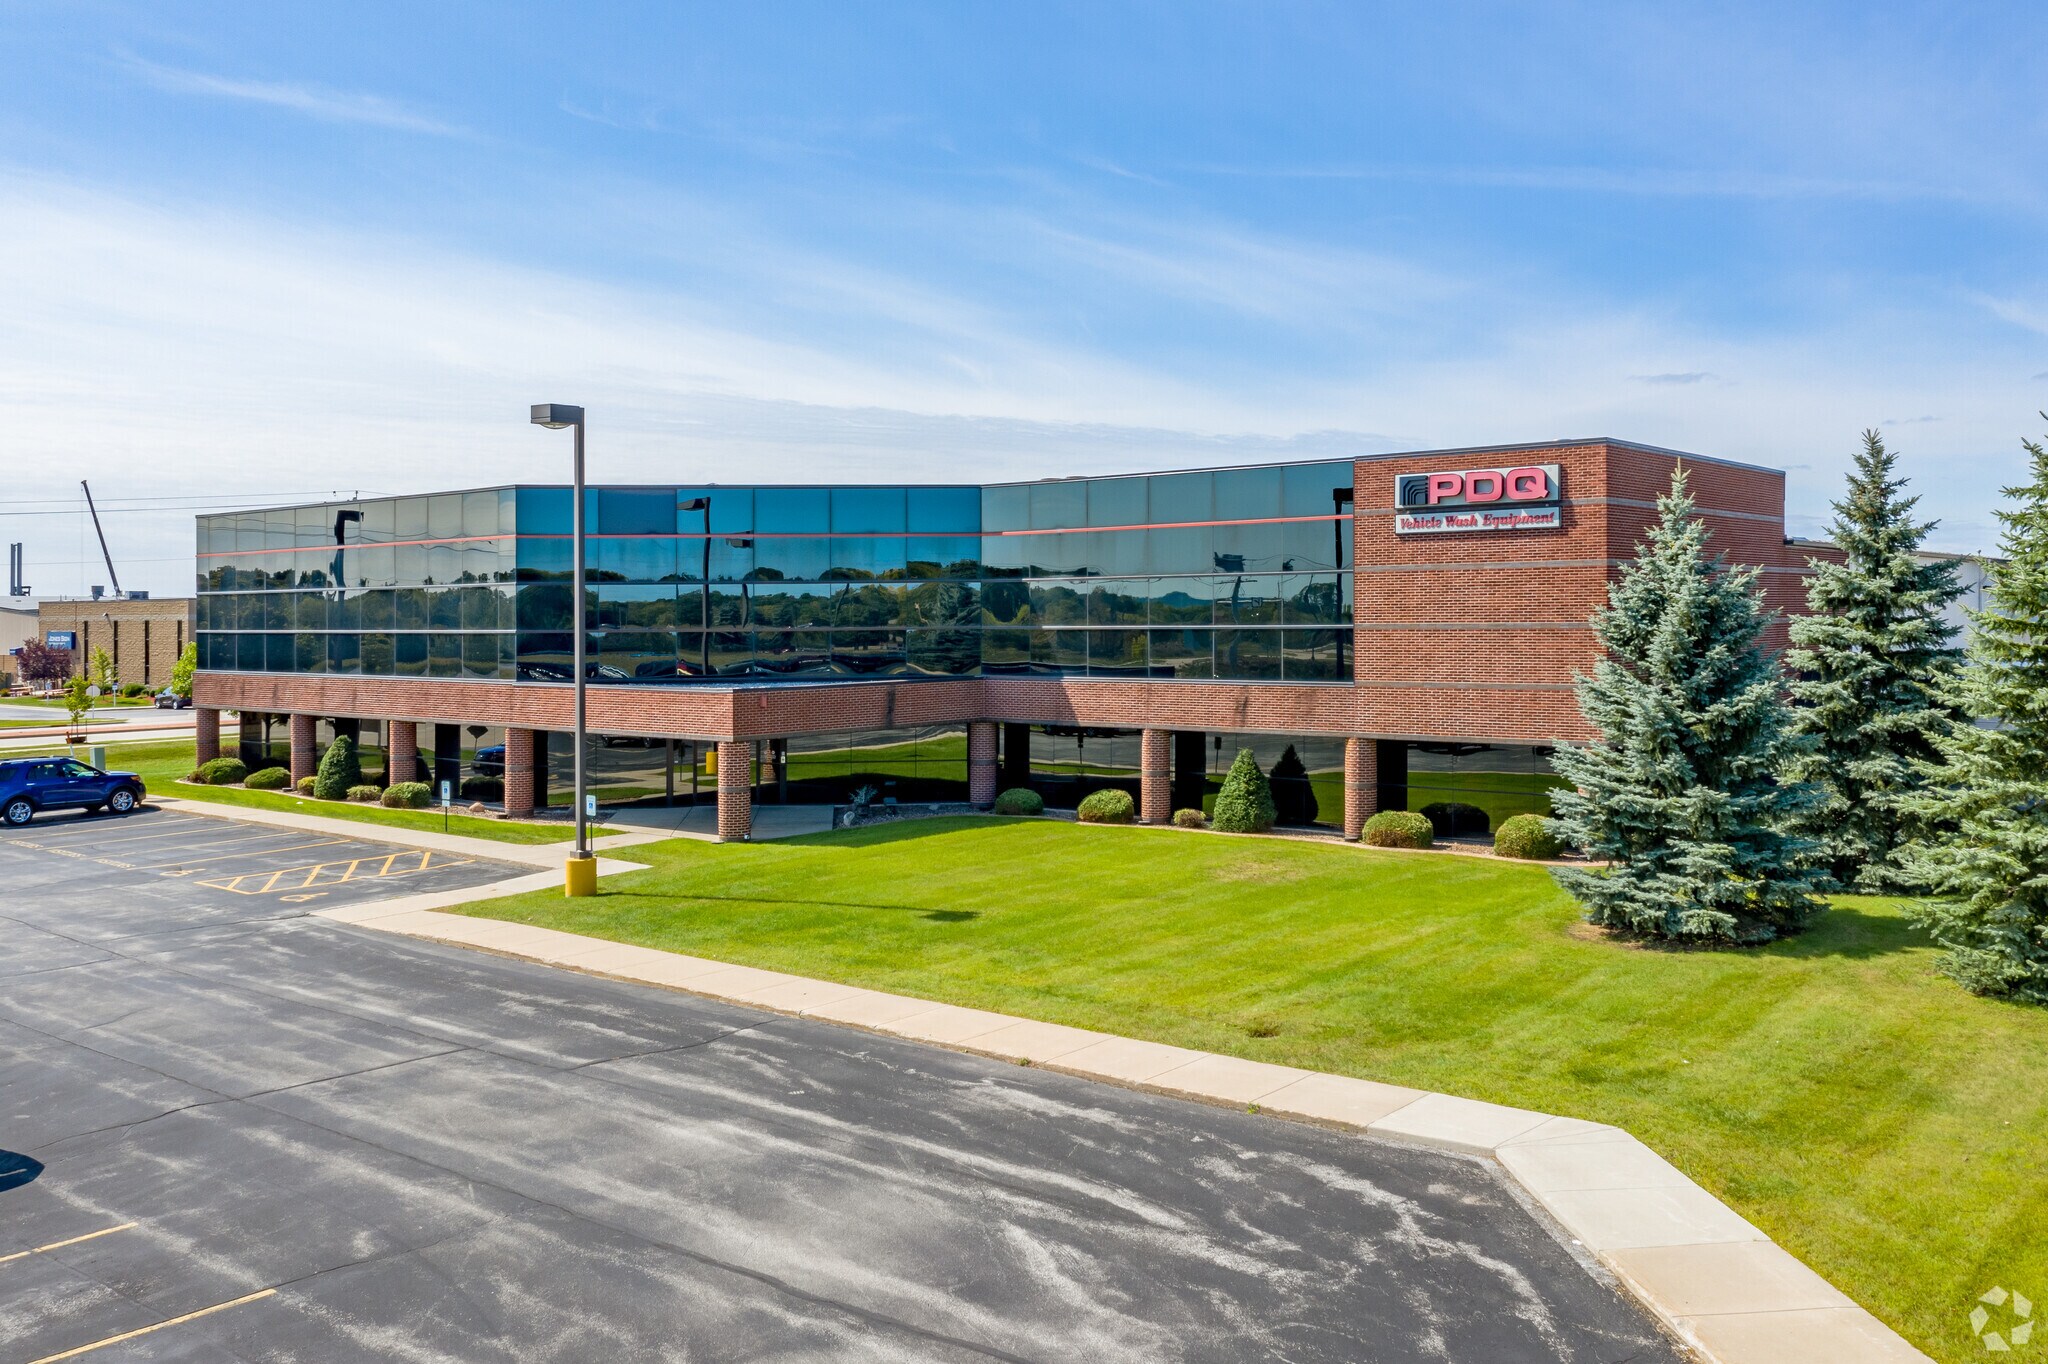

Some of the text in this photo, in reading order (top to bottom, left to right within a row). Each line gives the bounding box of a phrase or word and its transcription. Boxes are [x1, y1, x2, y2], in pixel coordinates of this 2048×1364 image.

[1429, 467, 1549, 505] PDQ
[1400, 511, 1555, 530] Vehicle Wash Equipment
